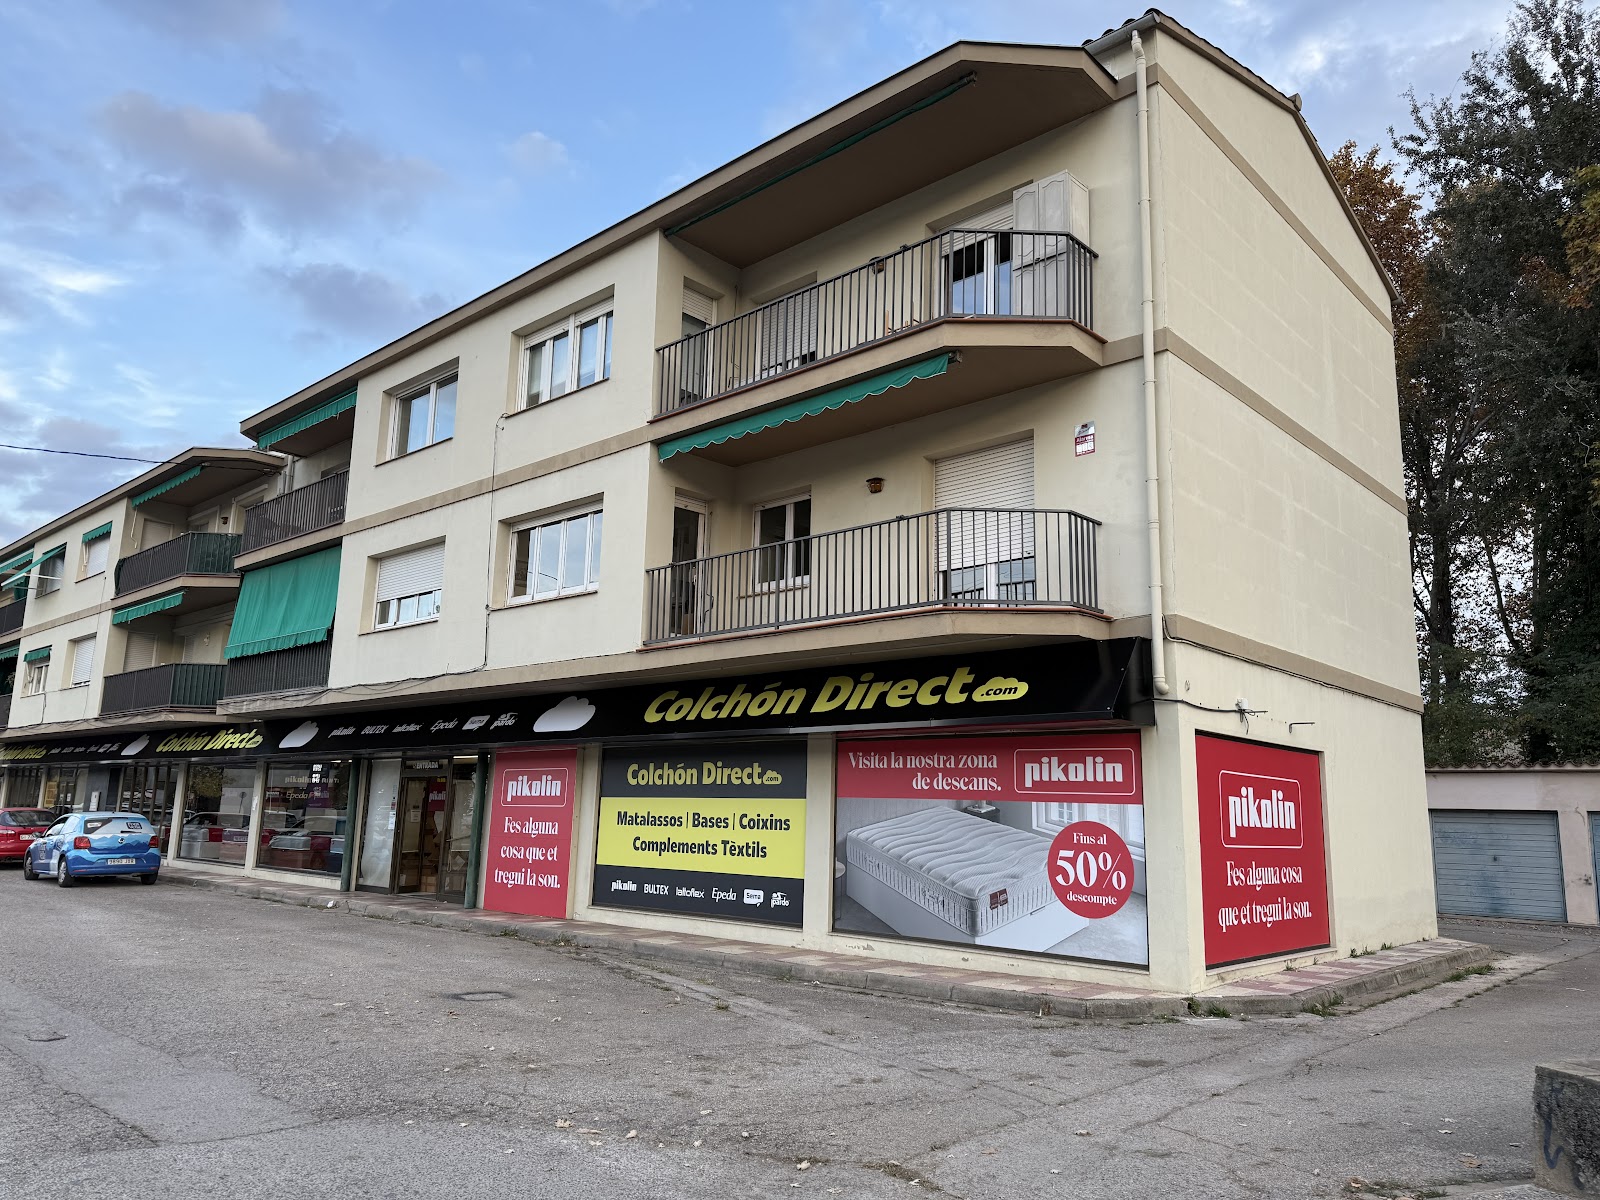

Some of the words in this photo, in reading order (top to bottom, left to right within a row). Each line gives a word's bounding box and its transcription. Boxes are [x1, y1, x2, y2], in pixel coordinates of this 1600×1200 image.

[644, 681, 807, 723] Colchón
[810, 667, 976, 714] Direct
[980, 684, 1018, 697] .com
[156, 732, 212, 752] Colchón
[203, 728, 258, 750] Direct
[848, 752, 888, 770] Visita
[890, 752, 903, 769] la
[906, 754, 954, 770] nostra
[958, 754, 998, 769] zona
[1024, 756, 1123, 788] pikolin
[627, 762, 698, 786] Colchón
[702, 761, 762, 785] Direct
[912, 772, 931, 790] de
[932, 773, 1002, 791] descans.
[507, 775, 561, 802] pikolin
[617, 811, 683, 828] Matalassos
[692, 812, 729, 829] Bases
[739, 813, 791, 831] Coixins
[1228, 786, 1296, 838] pikolin
[504, 816, 521, 834] Fes
[523, 817, 559, 838] alguna
[1073, 832, 1096, 845] Fins
[1097, 834, 1107, 845] al
[500, 845, 524, 859] cosa
[526, 845, 546, 863] que
[547, 845, 558, 861] et
[633, 836, 718, 856] Complements
[721, 839, 767, 858] Tèxtils
[494, 867, 525, 888] tregui
[526, 868, 536, 886] la
[538, 873, 561, 888] son.
[1055, 849, 1127, 891] 50%
[1226, 861, 1246, 887] Fes
[1247, 861, 1280, 891] alguna
[1281, 866, 1303, 884] cosa
[611, 880, 637, 892] pikolin
[643, 883, 669, 896] BULTEX
[712, 888, 737, 903] Epeda
[1067, 891, 1118, 907] descompte
[1218, 904, 1239, 933] que
[1240, 901, 1251, 925] et
[1252, 897, 1282, 928] tregui
[1283, 897, 1292, 920] la
[1293, 901, 1312, 919] son.
